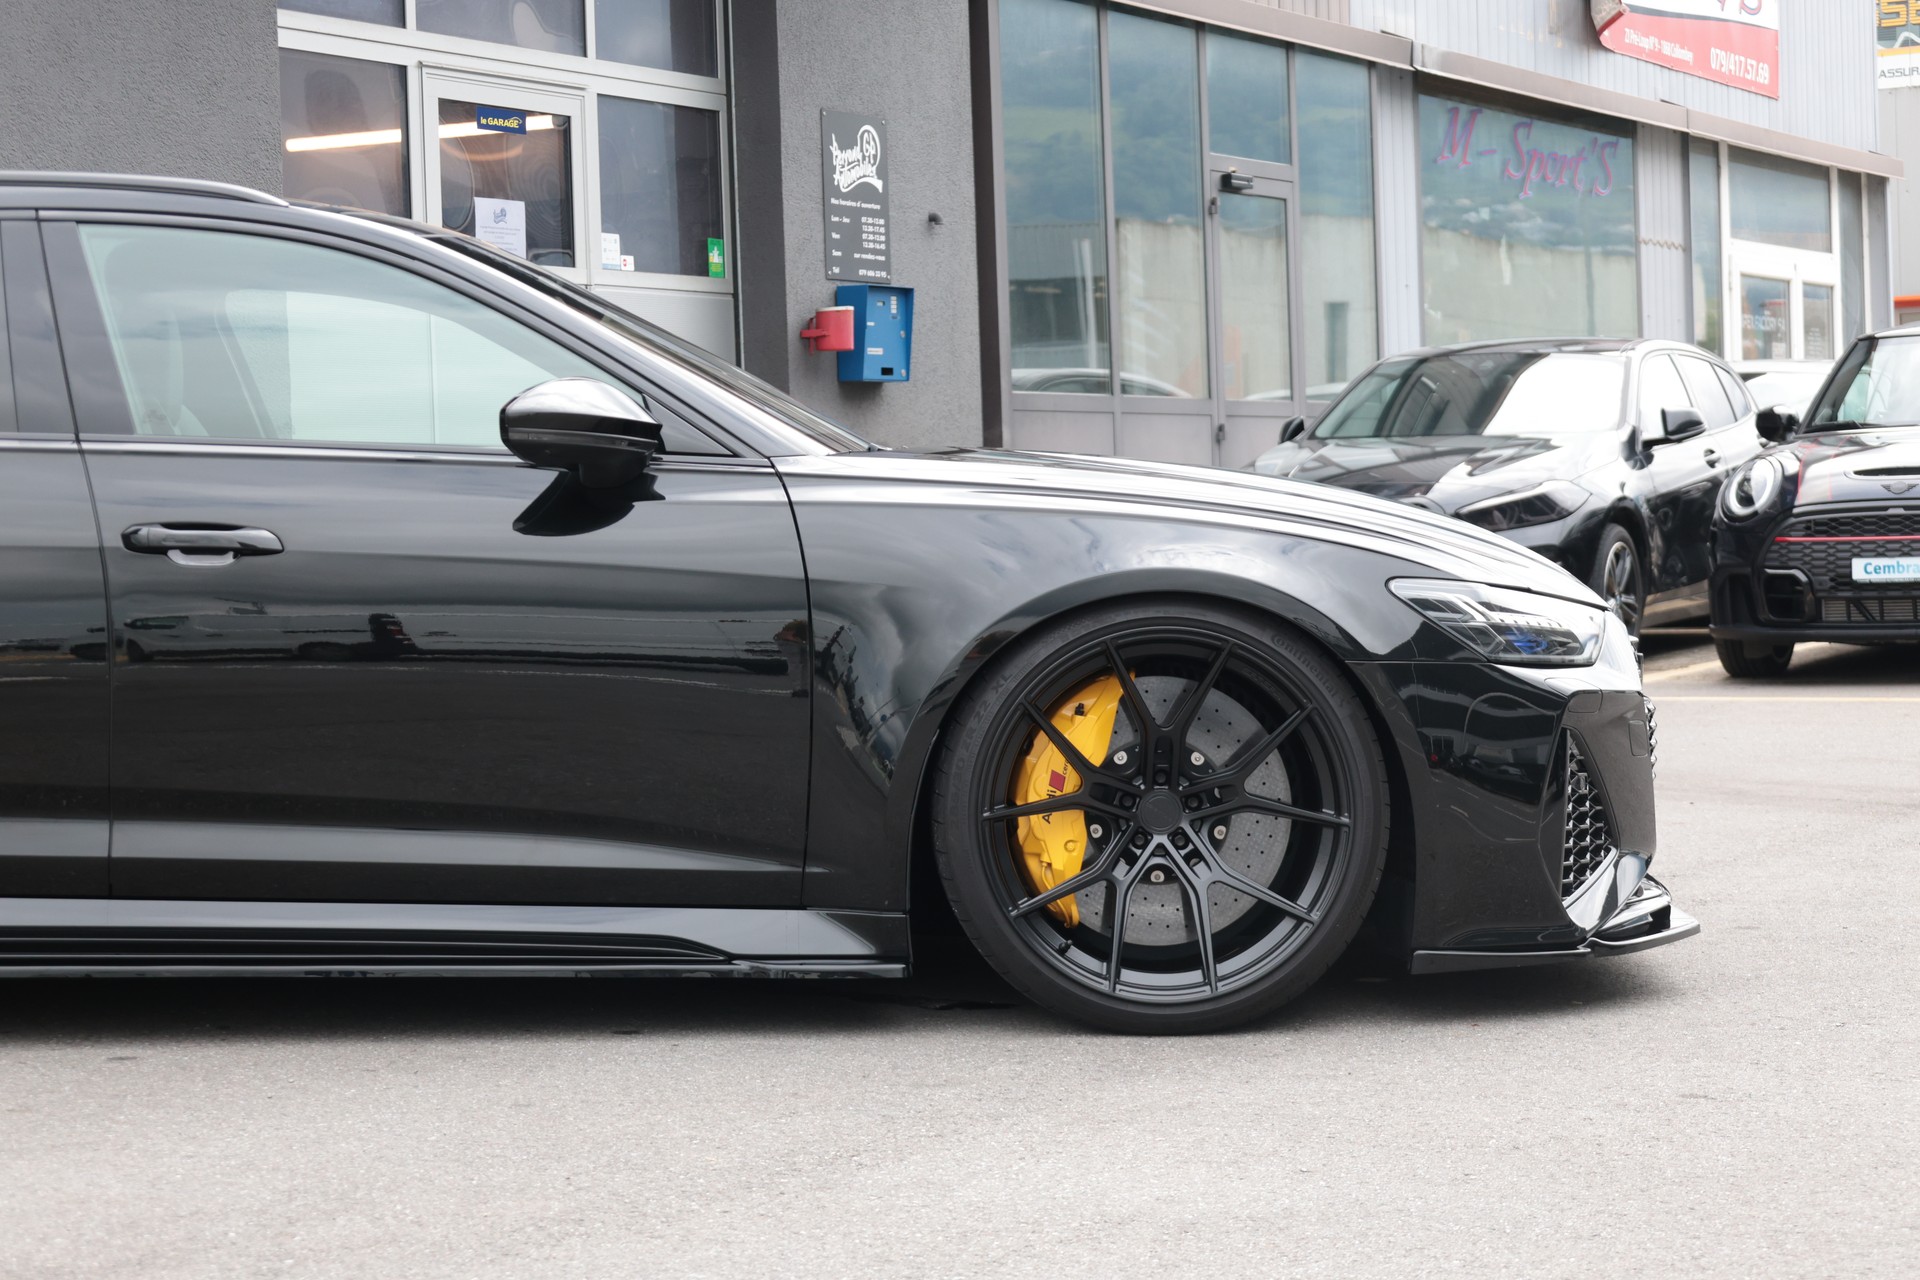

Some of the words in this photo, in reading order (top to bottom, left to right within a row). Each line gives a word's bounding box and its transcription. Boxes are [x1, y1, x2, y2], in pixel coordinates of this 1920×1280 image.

[1710, 47, 1770, 85] 079/417.57.69
[1879, 66, 1920, 79] ASSUR
[480, 116, 487, 124] le
[487, 117, 519, 128] GARAGE
[1863, 560, 1920, 575] Cembra
